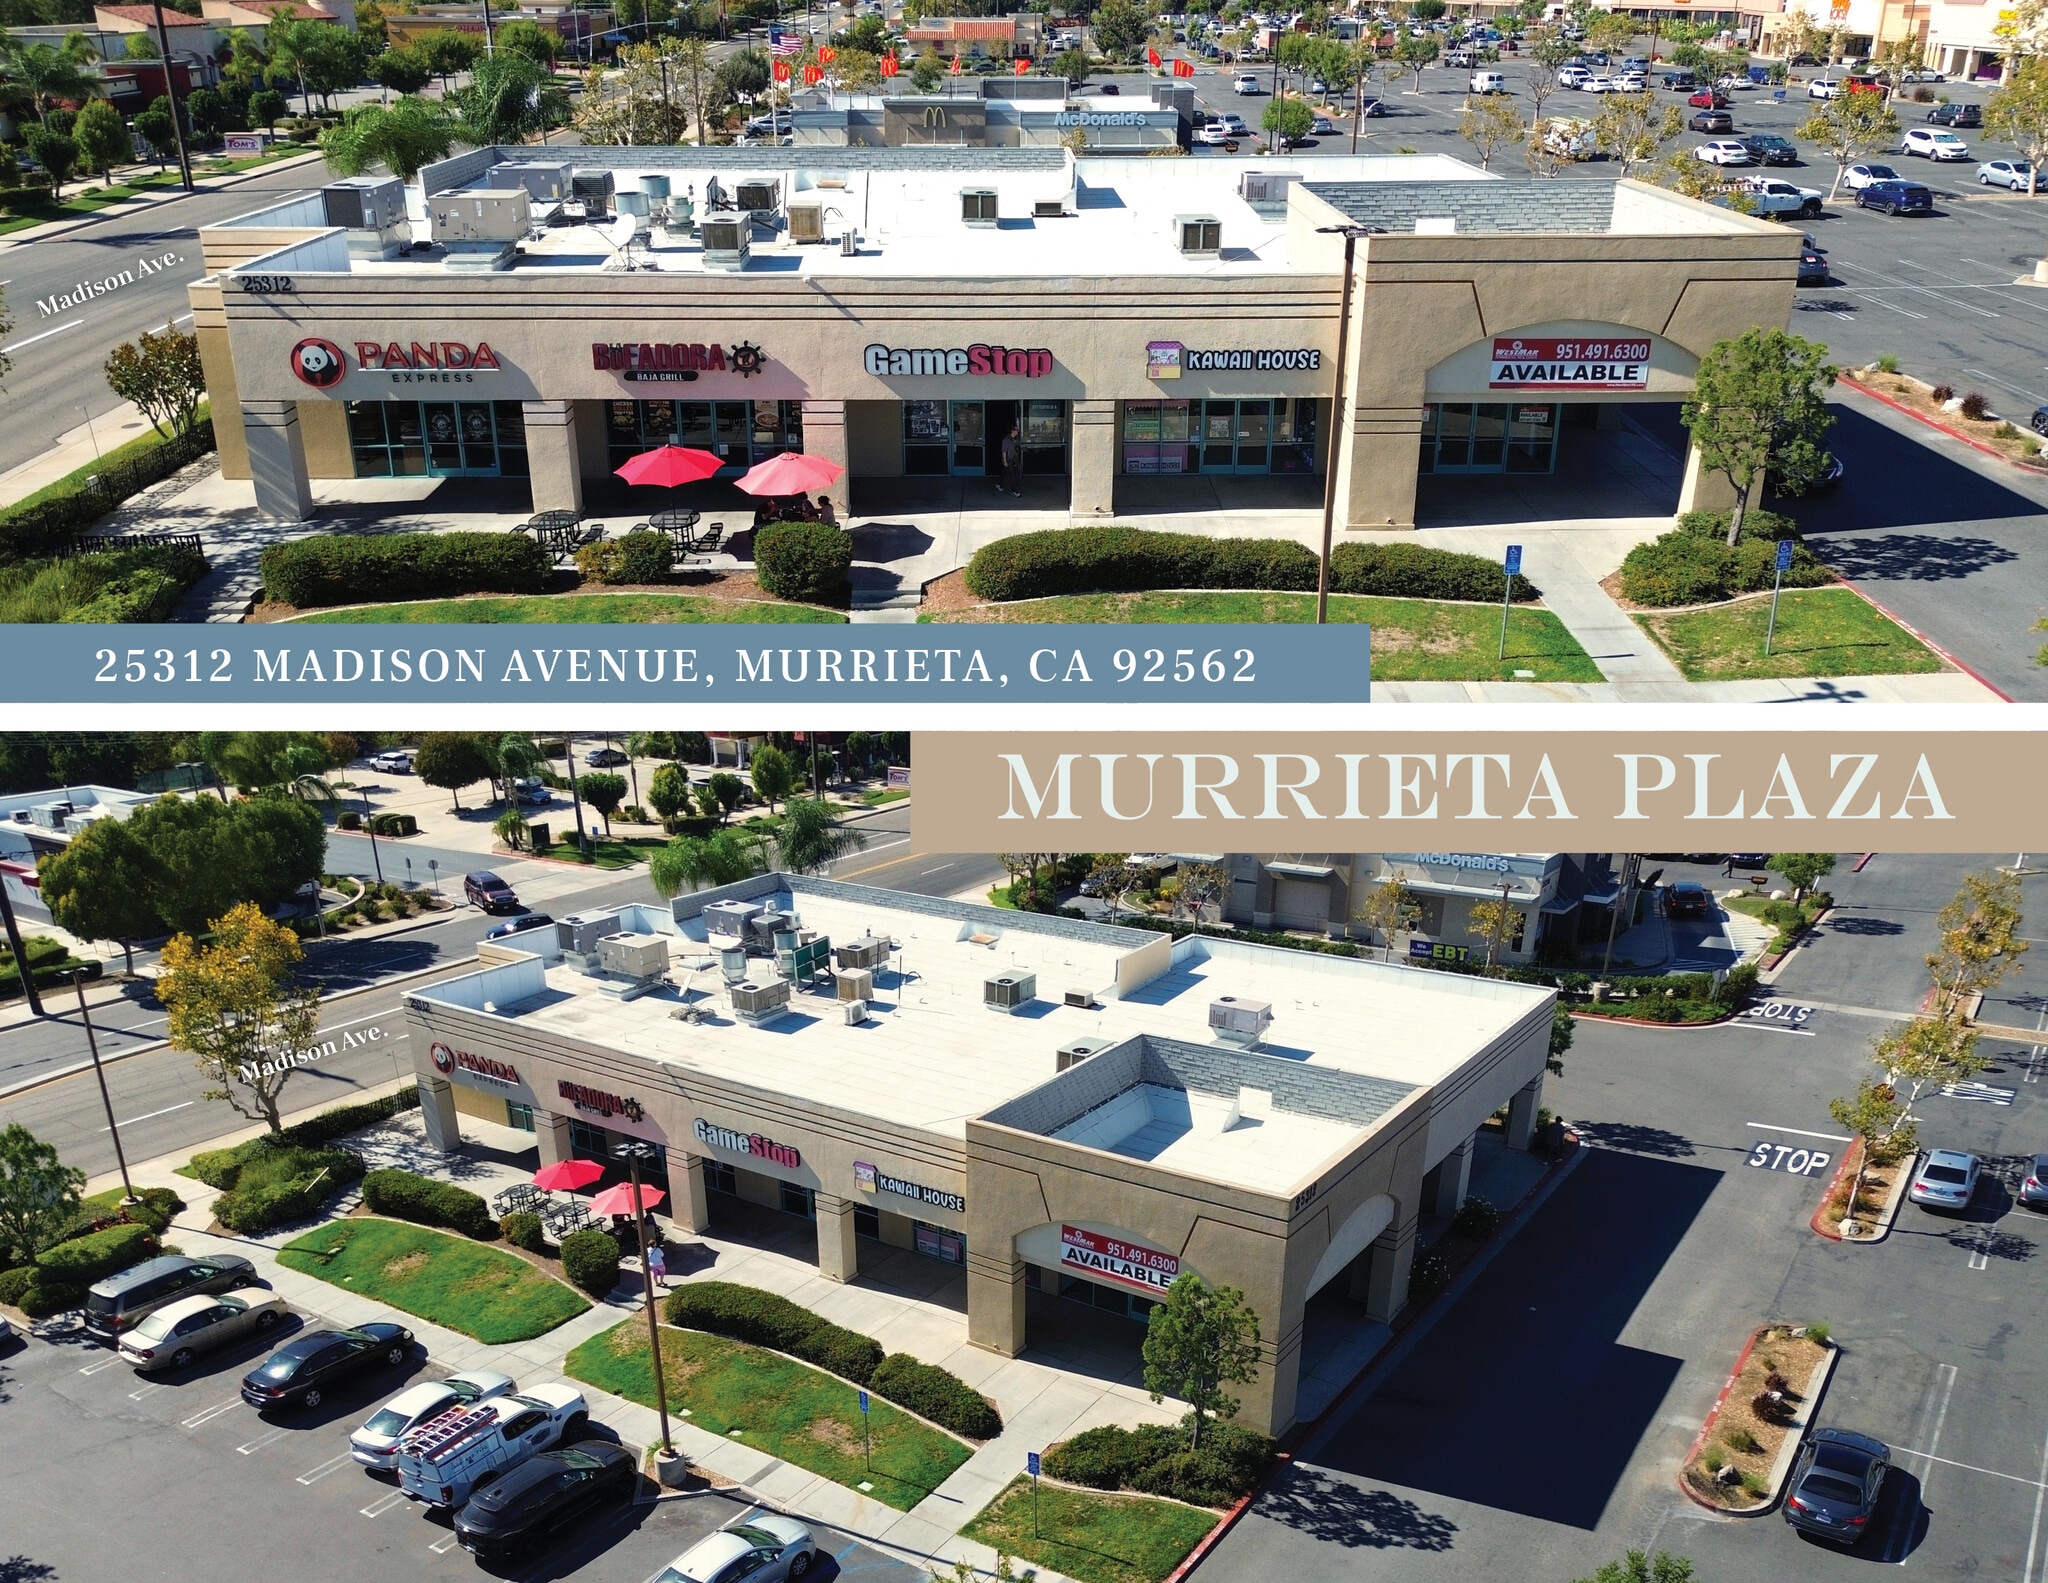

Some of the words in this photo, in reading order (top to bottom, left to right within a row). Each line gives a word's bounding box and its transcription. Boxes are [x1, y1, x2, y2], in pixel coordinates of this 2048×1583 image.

[1053, 112, 1146, 126] McDonald's
[241, 276, 292, 292] 25312
[354, 341, 501, 369] PANDA
[864, 343, 1053, 378] GameStop
[1188, 350, 1253, 370] KAWAII
[1256, 350, 1321, 371] HOUSE
[1556, 344, 1648, 359] 951.491.6300
[392, 374, 473, 383] EXPRESS
[637, 372, 658, 381] BAJA
[660, 373, 685, 381] GRILL
[1497, 364, 1640, 380] AVAILABLE
[1414, 853, 1509, 871] McDonald's
[1432, 944, 1469, 961] EBT
[1749, 1002, 1811, 1022] STOP
[455, 1049, 520, 1084] PANDA
[693, 1117, 801, 1168] GameStop
[1749, 1143, 1830, 1176] STOP
[879, 1175, 922, 1200] KAWAII
[923, 1188, 965, 1212] HOUSE
[1066, 1247, 1171, 1288] AVAILABLE
[1107, 1242, 1177, 1273] 951.491.6300
